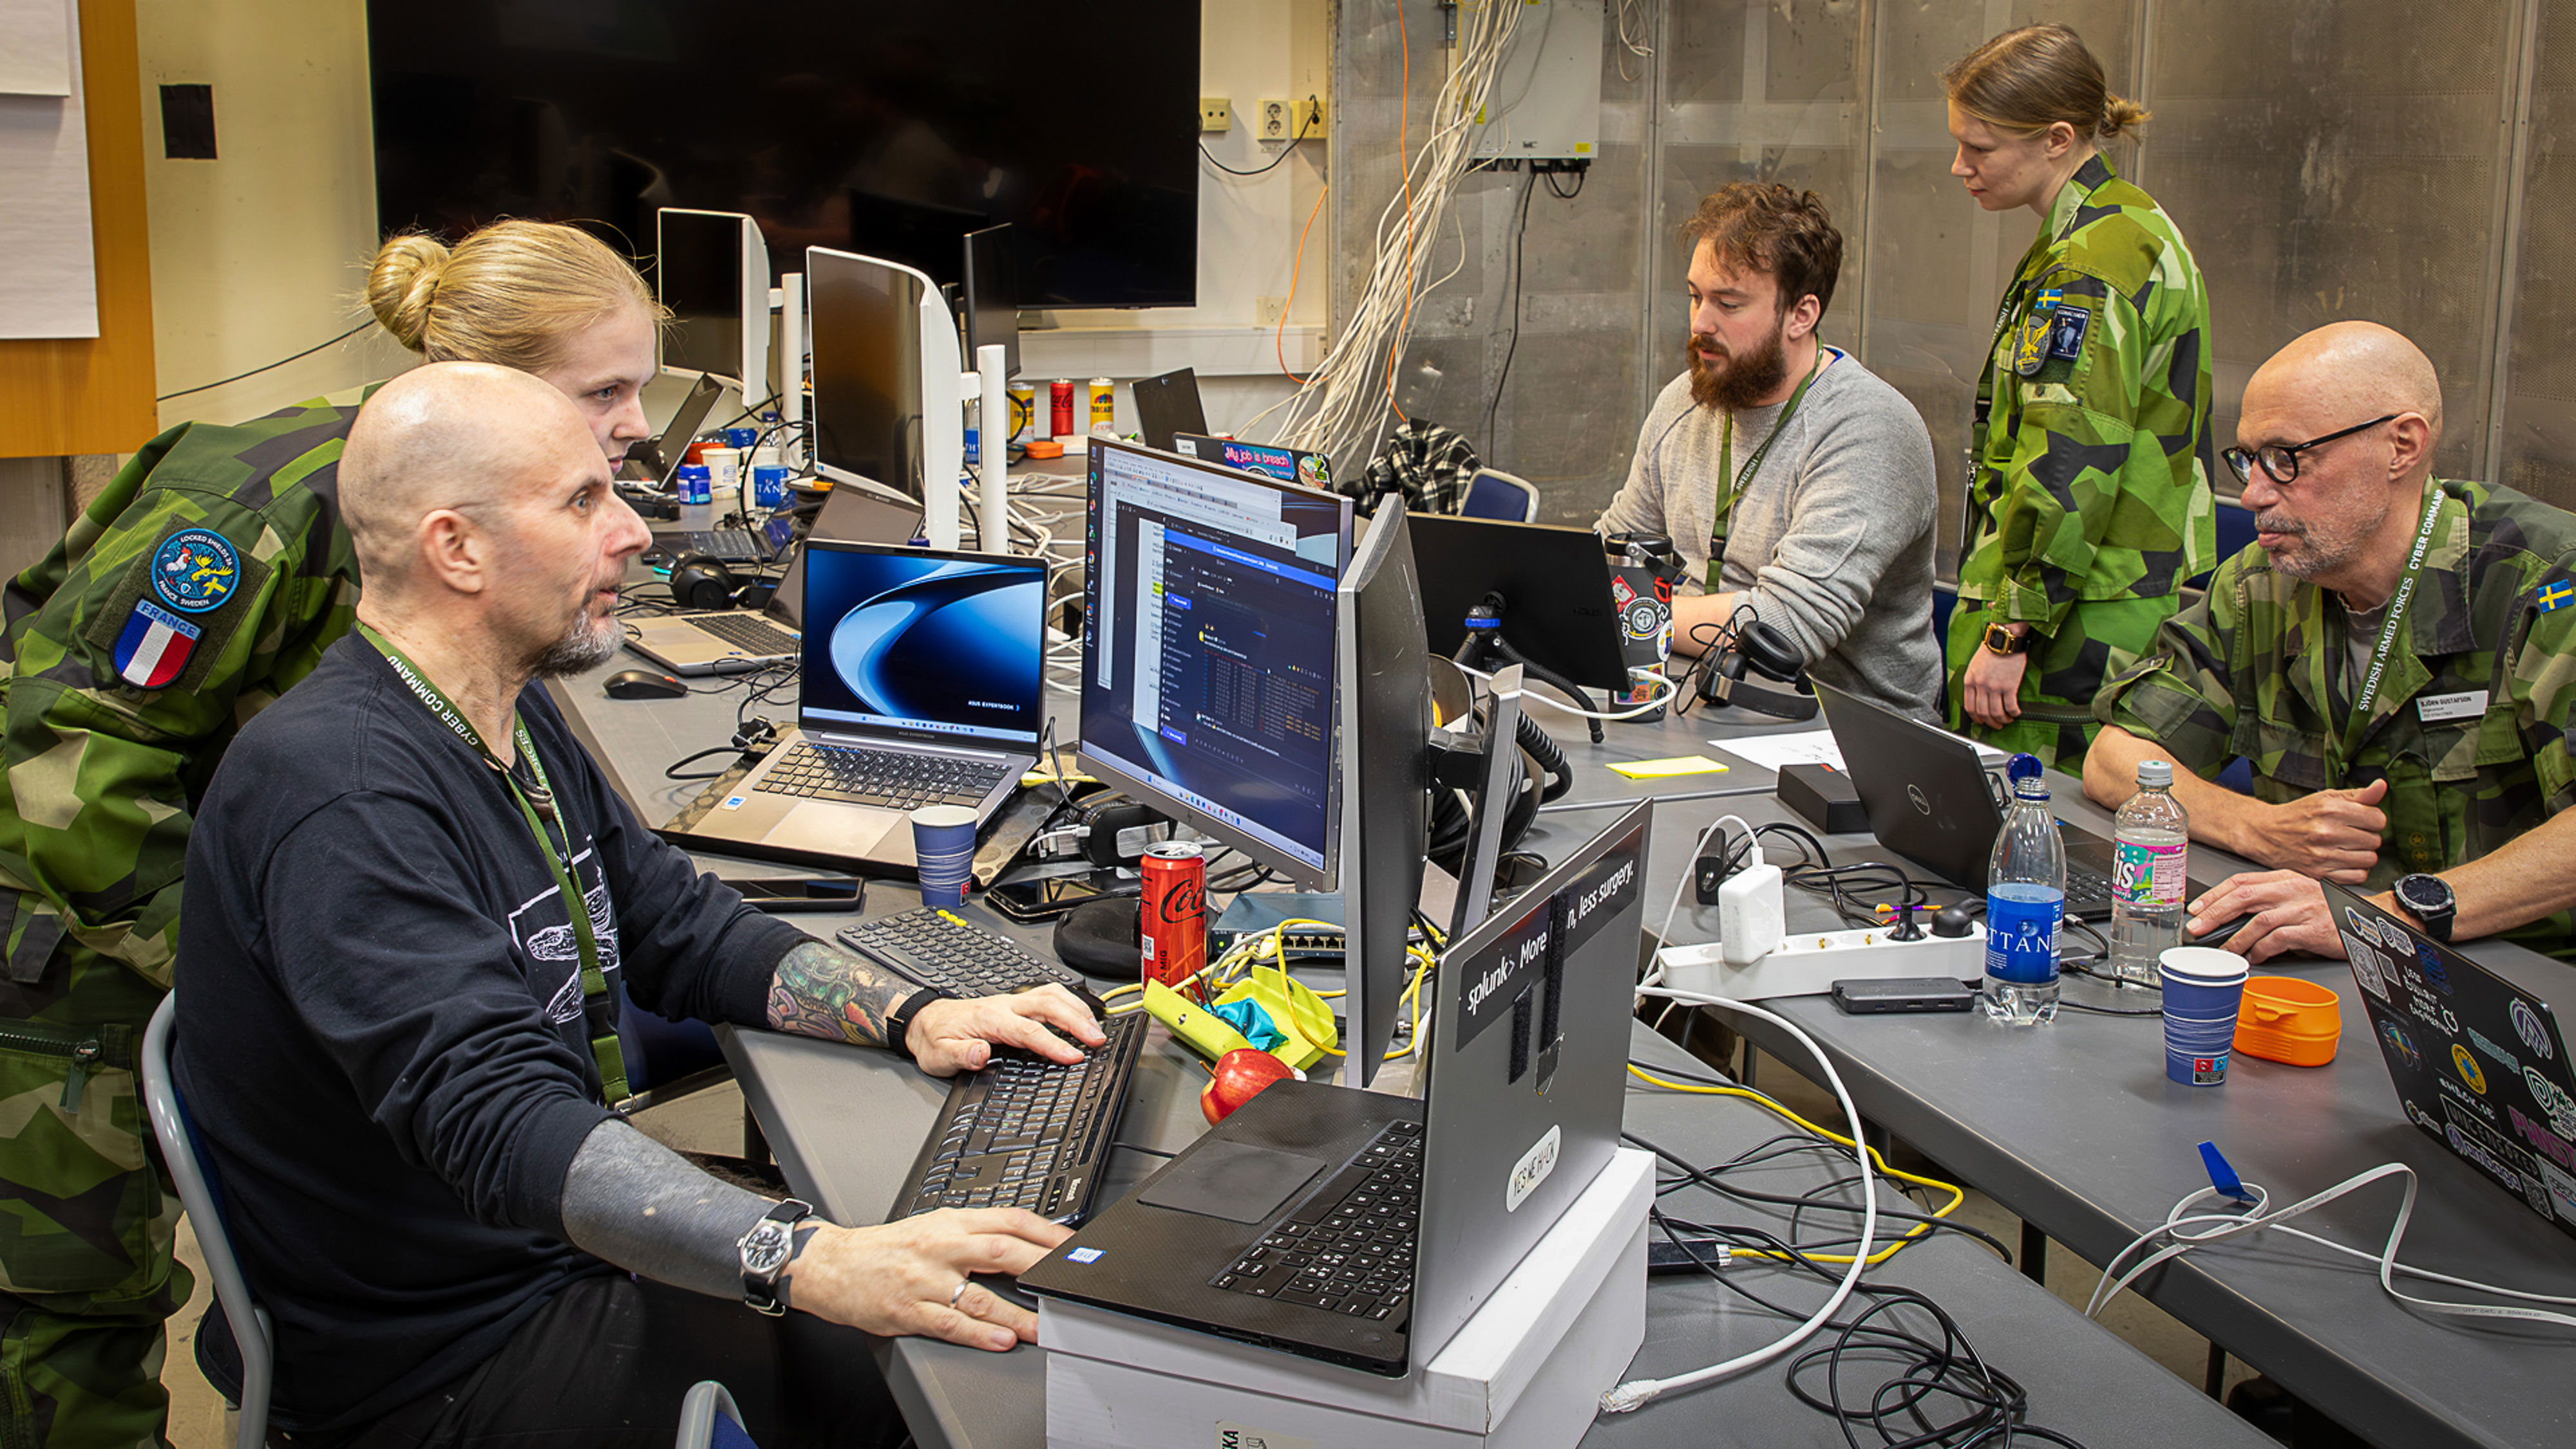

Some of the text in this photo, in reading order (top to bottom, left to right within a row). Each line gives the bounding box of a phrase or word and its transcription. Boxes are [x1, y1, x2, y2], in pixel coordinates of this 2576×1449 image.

[1226, 446, 1290, 468] My job is breach
[180, 535, 207, 543] LOCKED
[207, 538, 229, 559] SHIELDS
[2409, 489, 2445, 571] CYBER COMMAND
[158, 580, 178, 602] FRANCE
[141, 603, 197, 636] FRANCE
[2358, 577, 2414, 712] SWEDISH ARMED FORCES
[387, 655, 478, 746] CYBER COMMAND
[515, 729, 545, 781] FORCES
[1520, 931, 1548, 969] More
[1578, 890, 1598, 920] less
[1598, 859, 1634, 903] surgery.
